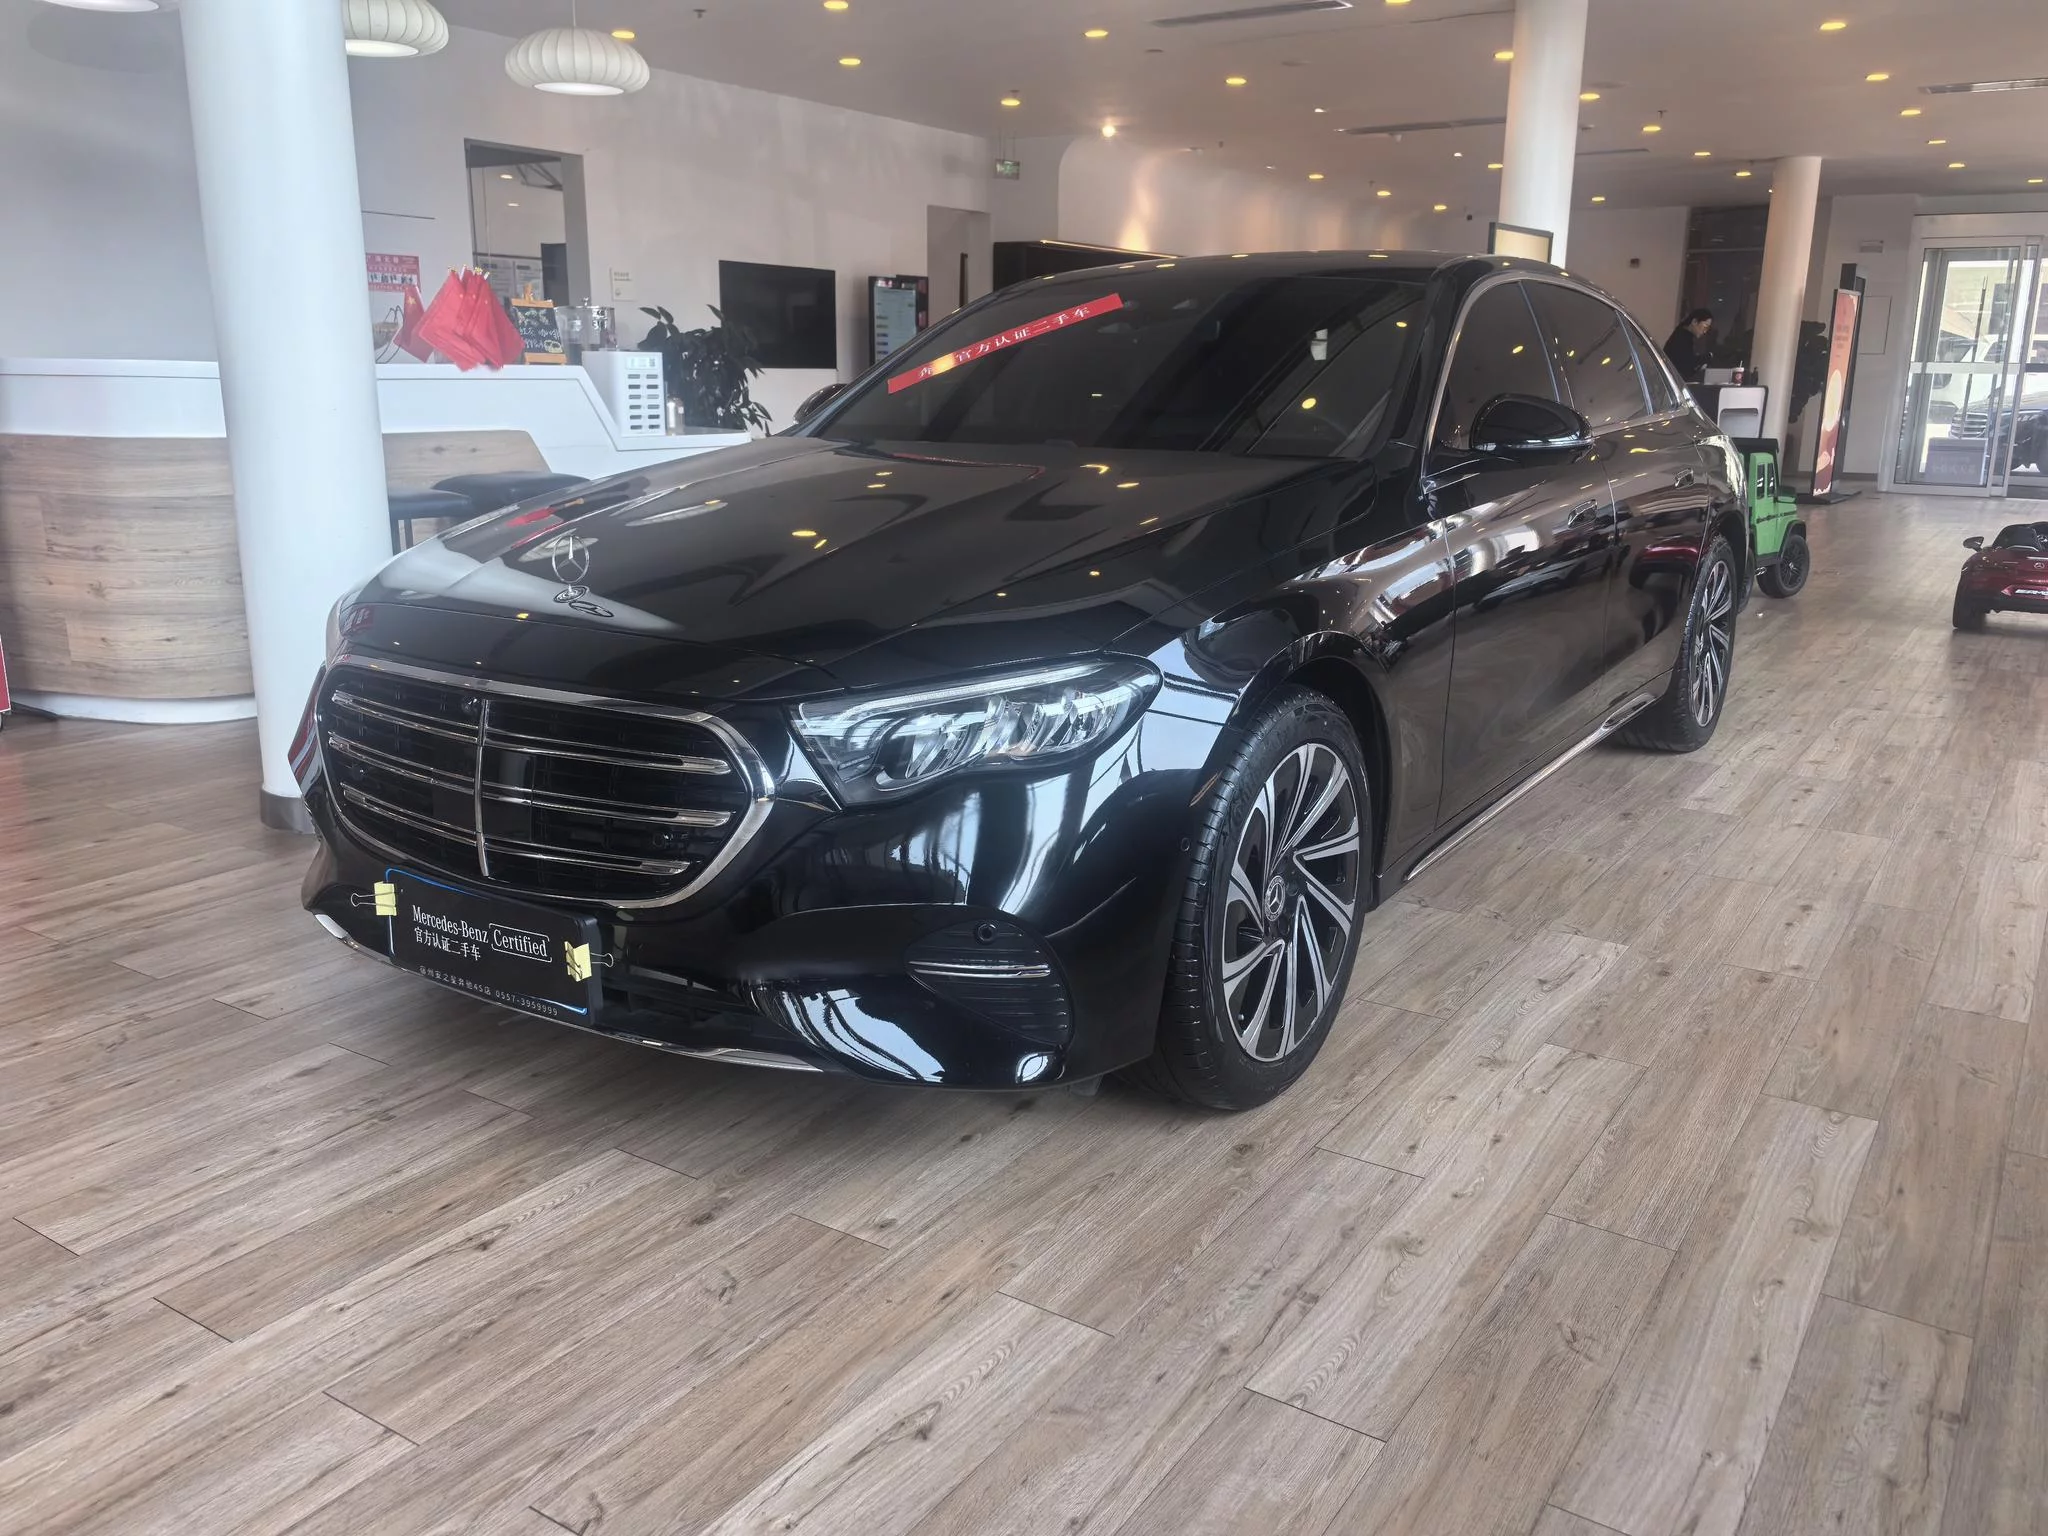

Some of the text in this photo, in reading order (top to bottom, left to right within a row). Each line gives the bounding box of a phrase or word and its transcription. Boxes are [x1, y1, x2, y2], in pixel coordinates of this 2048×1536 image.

[412, 904, 548, 958] Mercedes-Benz Certified
[414, 926, 481, 961] 官方认证二手车
